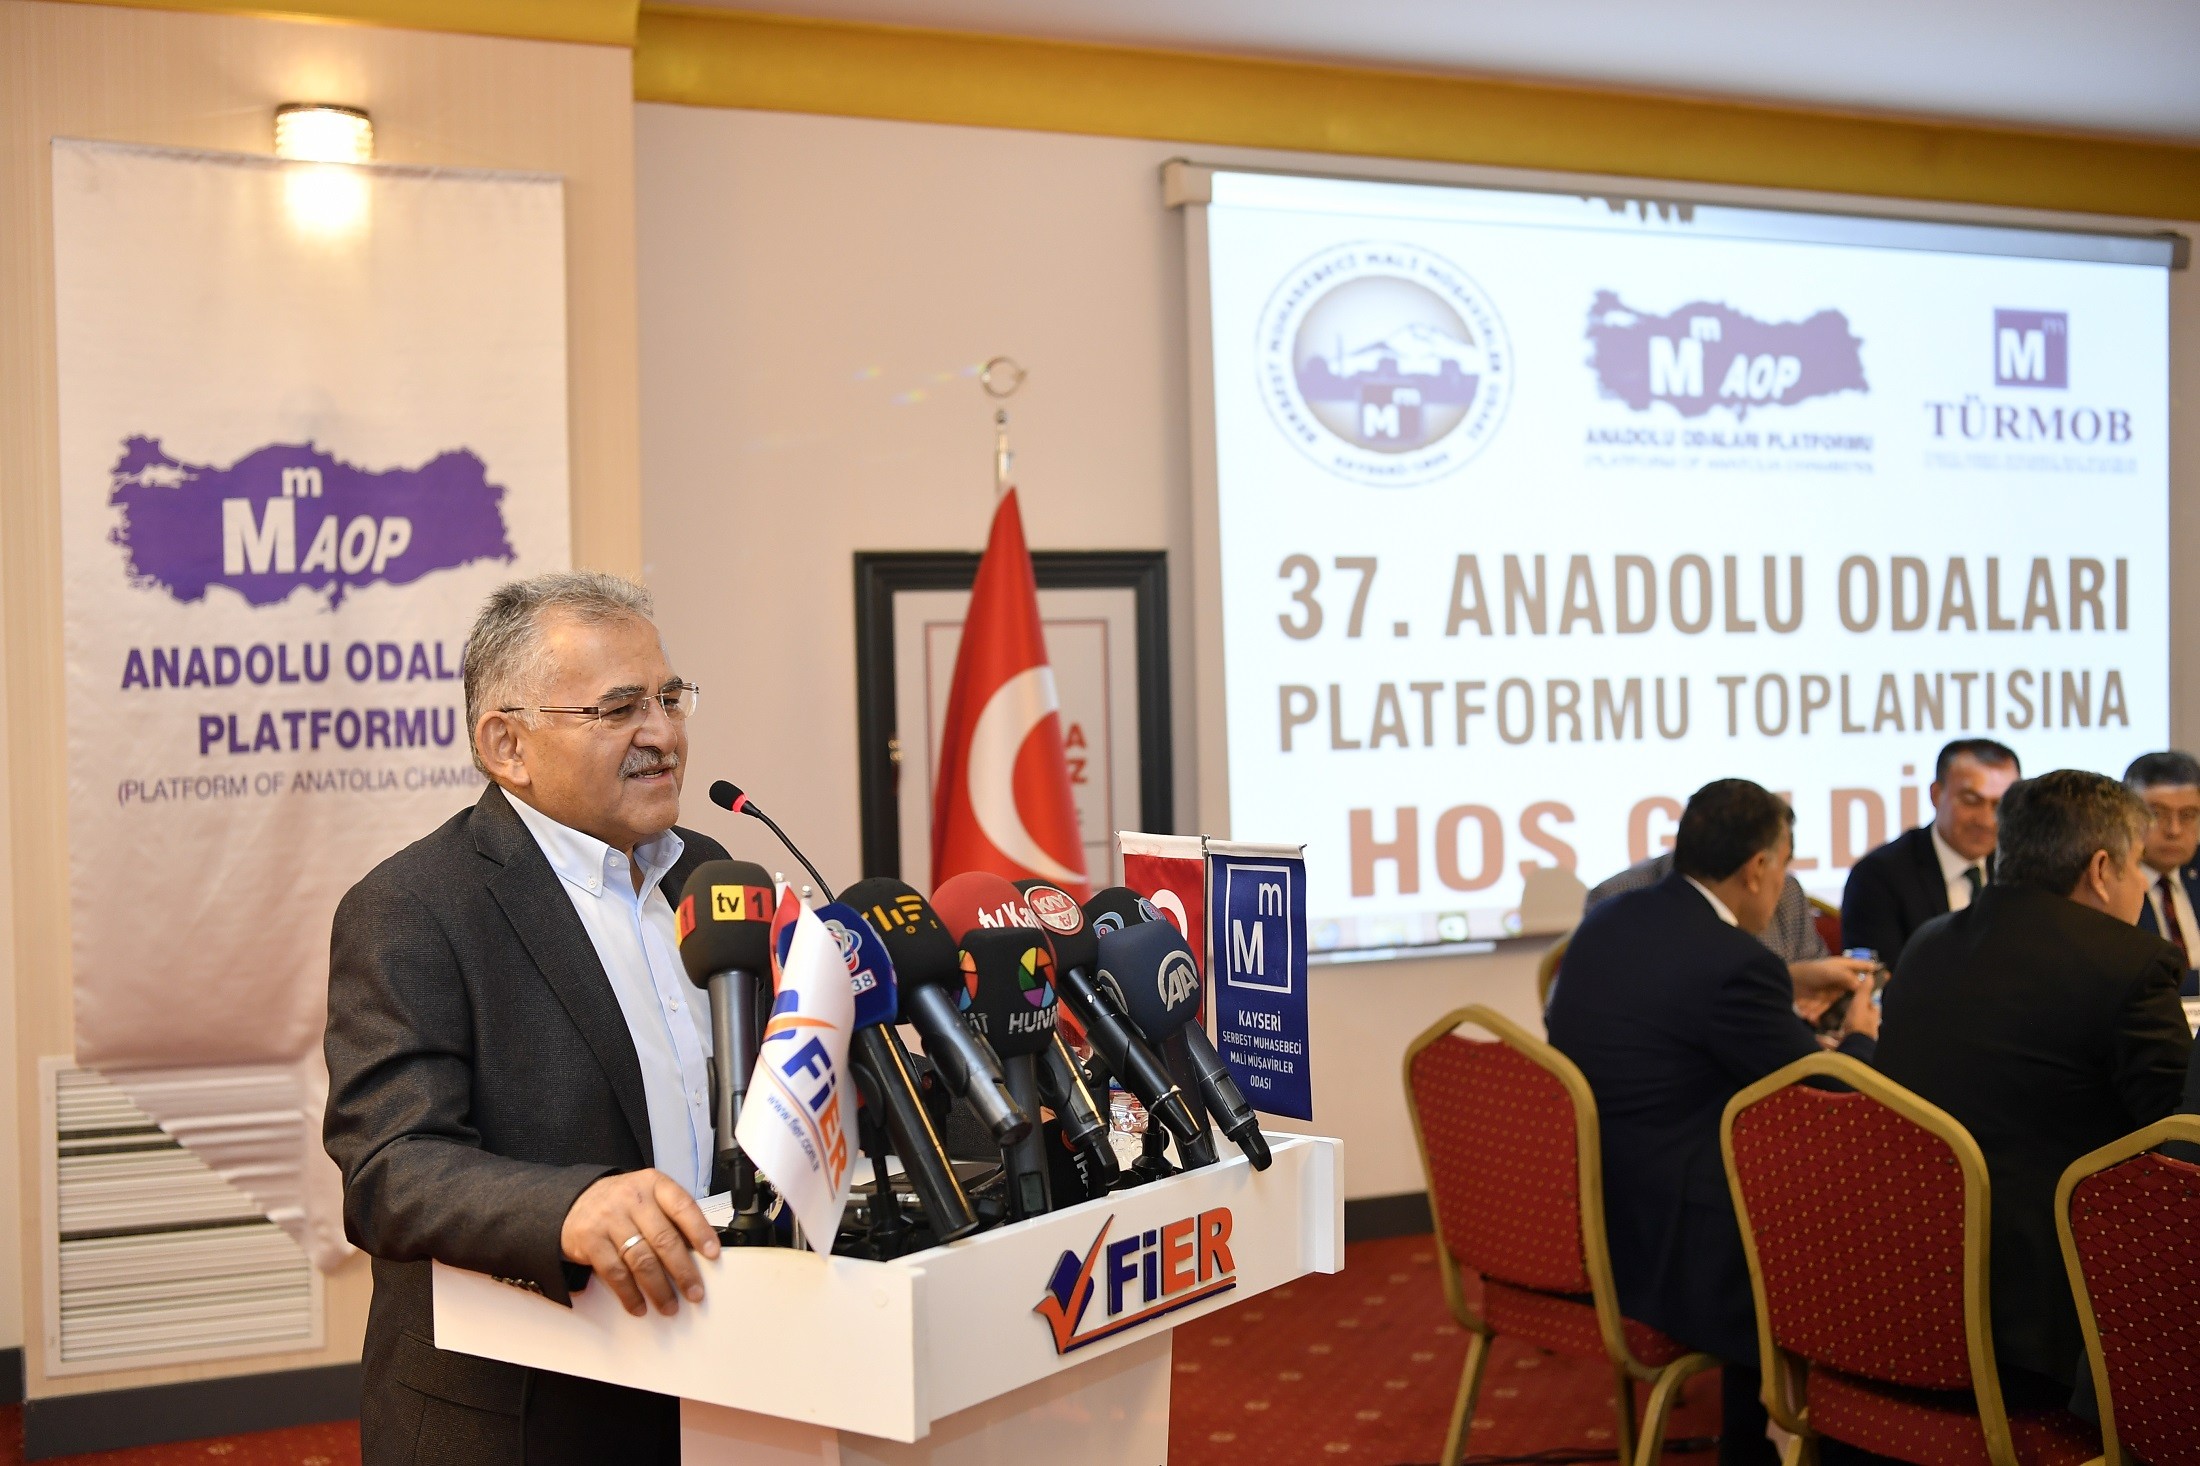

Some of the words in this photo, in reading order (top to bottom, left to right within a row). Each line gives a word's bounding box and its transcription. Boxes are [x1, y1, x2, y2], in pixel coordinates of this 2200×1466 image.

[1649, 337, 1704, 397] M
[1720, 355, 1802, 399] AOP
[2000, 327, 2045, 381] M
[1924, 393, 2133, 444] TÜRMOB
[222, 497, 297, 576] M
[301, 514, 413, 575] AOP
[1278, 553, 1409, 641] 37.
[1445, 554, 1803, 636] ANADOLU
[1838, 554, 2129, 633] ODALARI
[121, 642, 330, 689] ANADOLU
[199, 706, 456, 756] PLATFORMU
[1278, 676, 1689, 752] PLATFORMU
[1716, 668, 2130, 737] TOPLANTISINA
[118, 775, 248, 806] (PLATFORM
[254, 772, 285, 796] OF
[291, 768, 398, 795] ANATOLIA
[403, 763, 488, 793] CHAMB
[1258, 882, 1282, 917] m
[1233, 919, 1264, 976] M
[1167, 963, 1199, 1012] AA
[1222, 1030, 1252, 1047] SERBEST
[1253, 1036, 1302, 1055] MUHASEBECİ
[1238, 1009, 1281, 1032] KAYSERİ
[1230, 1050, 1247, 1066] MALİ
[1247, 1052, 1294, 1075] MÜŞAVİRLER
[1250, 1074, 1272, 1091] ODASI
